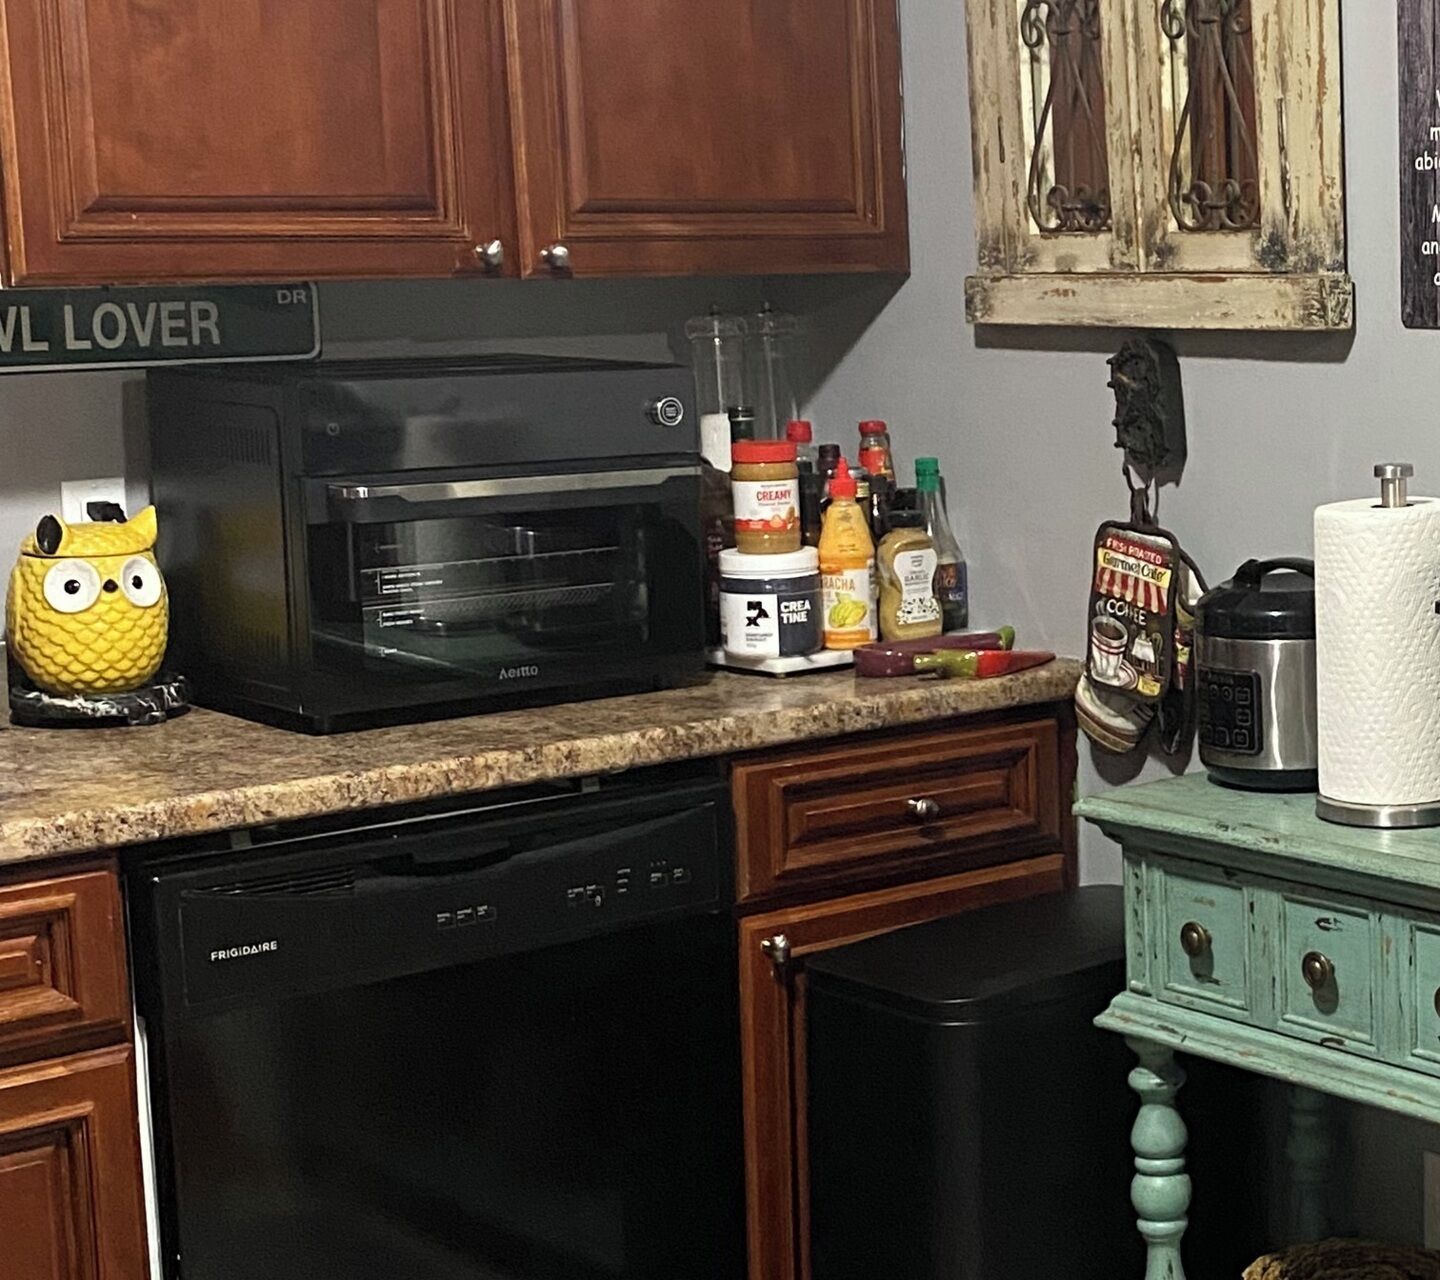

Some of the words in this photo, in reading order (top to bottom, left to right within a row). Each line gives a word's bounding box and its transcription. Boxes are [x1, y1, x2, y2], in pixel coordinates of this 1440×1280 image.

[276, 289, 307, 305] DR
[63, 300, 221, 351] LOVER
[757, 489, 791, 501] CREAMY
[780, 600, 811, 613] CREA
[780, 612, 808, 624] TINE
[210, 940, 278, 961] FRIGIDAIRE
